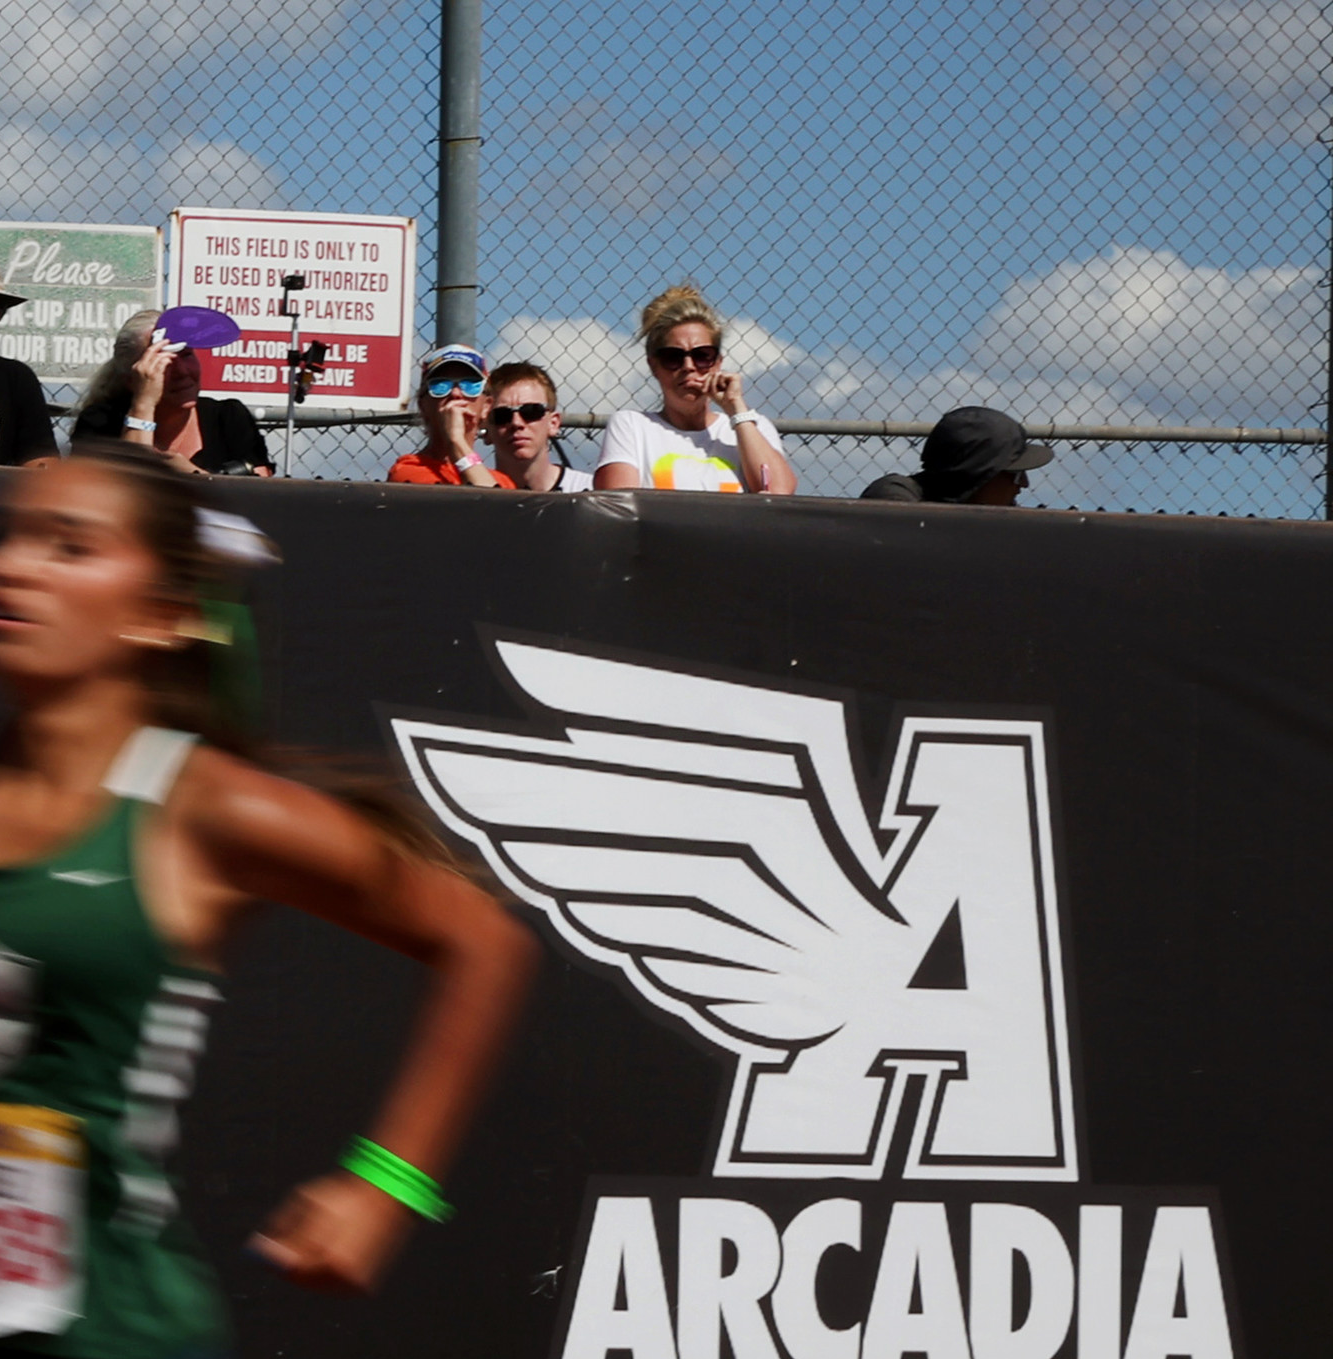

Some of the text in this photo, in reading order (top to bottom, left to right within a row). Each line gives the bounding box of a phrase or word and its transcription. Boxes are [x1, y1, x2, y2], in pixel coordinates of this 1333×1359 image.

[206, 236, 380, 262] THIS FIELD IS ONLY TO
[4, 240, 116, 286] Please
[194, 266, 214, 285] BE
[220, 267, 261, 287] USED
[69, 301, 109, 329] ALL
[206, 296, 260, 316] TEAMS
[305, 300, 375, 321] PLAYERS
[346, 344, 368, 363] BE
[222, 364, 277, 384] ASKED
[304, 368, 355, 387] EAVE
